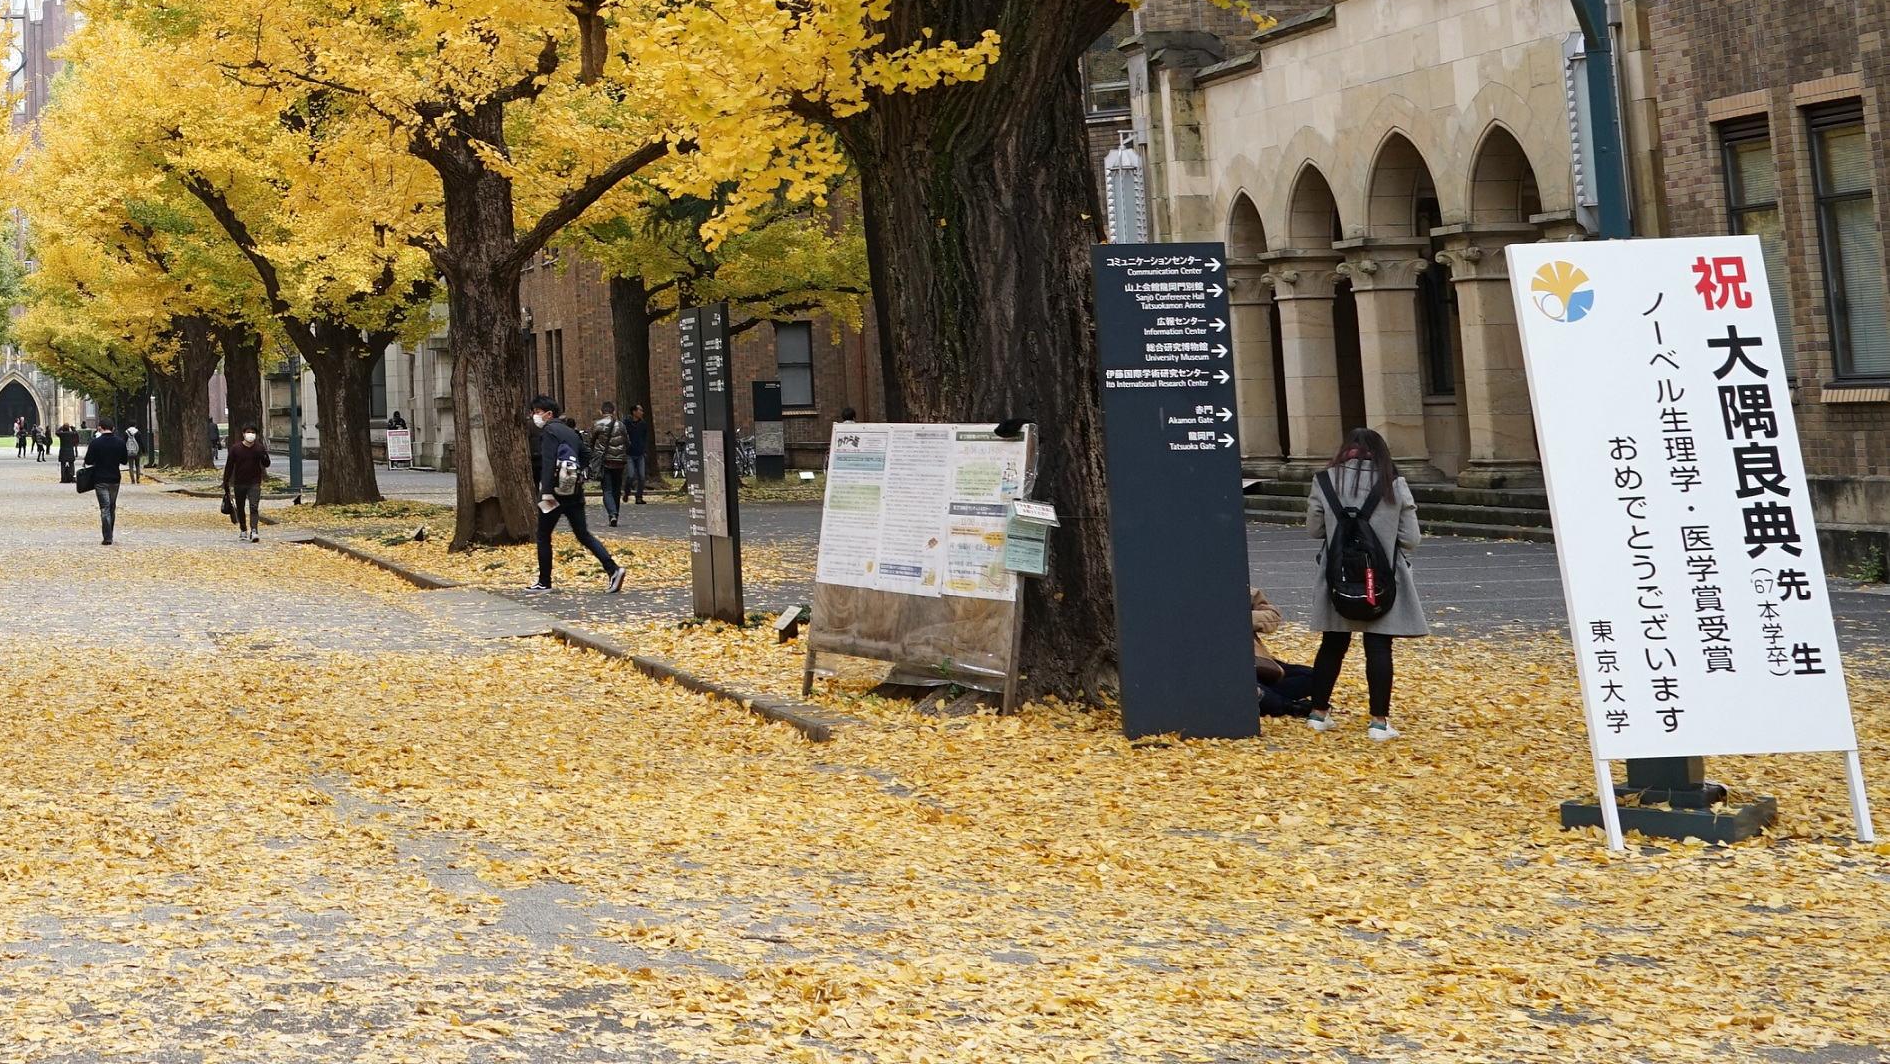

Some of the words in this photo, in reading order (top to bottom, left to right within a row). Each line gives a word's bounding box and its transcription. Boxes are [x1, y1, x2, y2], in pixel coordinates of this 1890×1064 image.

[1106, 255, 1202, 267] コミュニケーションセンター
[1127, 268, 1179, 276] Communication
[1180, 267, 1203, 275] Center
[1691, 256, 1753, 310] 祝
[1155, 293, 1191, 301] Conference
[1191, 292, 1206, 300] Hall
[1140, 302, 1183, 310] Tatsuokamon
[1184, 301, 1206, 309] Annex
[1156, 316, 1207, 326] 広報センター
[1143, 327, 1183, 336] Information
[1184, 327, 1207, 335] Center
[1145, 341, 1209, 353] 総合研究博物館
[1144, 354, 1179, 363] University
[1180, 353, 1210, 361] Museum
[1116, 379, 1157, 388] International
[1158, 379, 1186, 388] Research
[1187, 378, 1209, 387] Center
[1195, 404, 1214, 415] 赤門
[1167, 416, 1197, 424] Akamon
[1197, 416, 1215, 424] Gate
[1168, 442, 1199, 451] Tatsuoka
[1199, 441, 1217, 450] Gate
[1608, 436, 1685, 733] おめでとうございます
[1590, 619, 1630, 734] 東京大学
